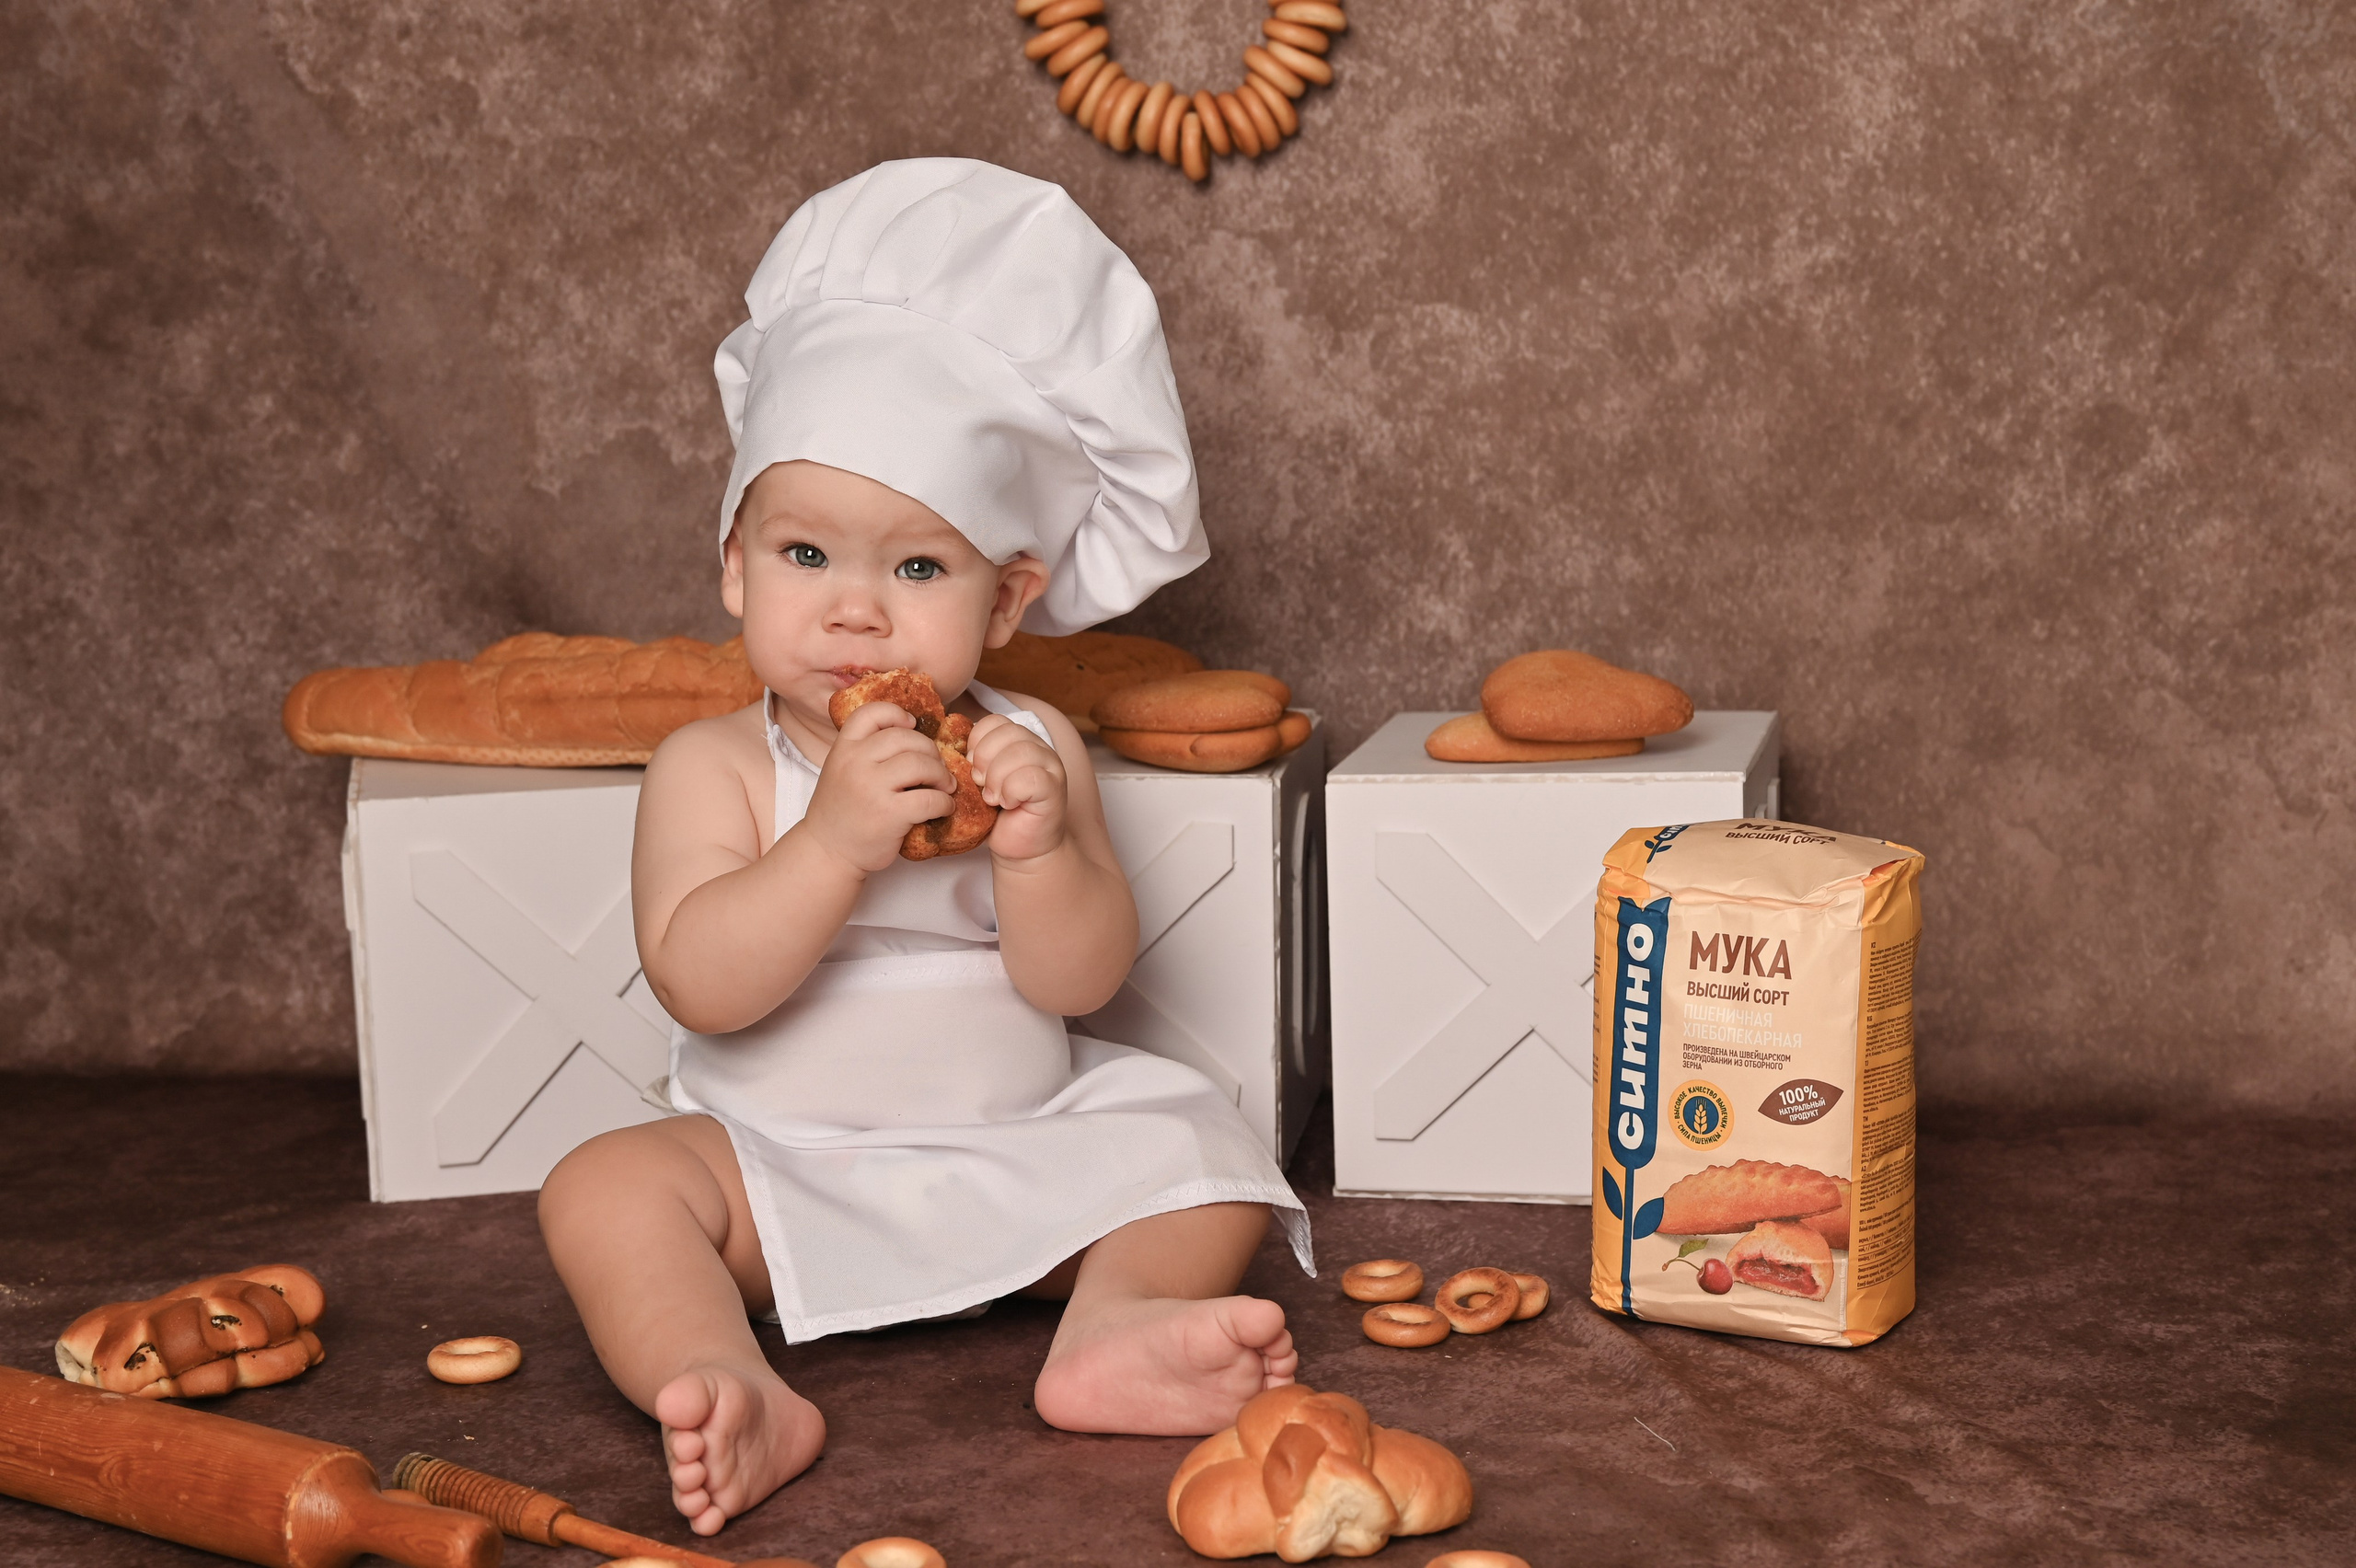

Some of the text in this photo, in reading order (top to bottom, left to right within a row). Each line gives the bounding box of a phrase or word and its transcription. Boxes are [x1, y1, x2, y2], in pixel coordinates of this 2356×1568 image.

[1725, 832, 1831, 845] ВЫСШИЙ СОРТ
[1734, 823, 1837, 842] МУКА
[1689, 930, 1793, 980] МУКА
[1686, 981, 1790, 1006] ВЫСШИЙ СОРТ
[1683, 1003, 1773, 1028] ПШЕНИЧНАЯ
[1682, 1022, 1802, 1048] ХЛЕБОПЕКАРНАЯ
[1682, 1043, 1791, 1063] ПРОИЗВЕДЕНА НА ШВЕЙЦАРСКОМ
[1682, 1052, 1784, 1070] ОБОРУДОВАНИИ ИЗ ОТБОРНОГО
[1682, 1061, 1703, 1071] ЗЕРНА
[1778, 1084, 1819, 1105] 100%
[1674, 1086, 1728, 1129] ВЫСОКОЕ КАЧЕСТВО ВЫПЕЧКИ
[1778, 1096, 1826, 1116] НАТУРАЛЬНЫЙ
[1789, 1109, 1819, 1122] ПРОДУКТ
[1678, 1124, 1722, 1145] СИЛА ПШЕНИЦЫ
